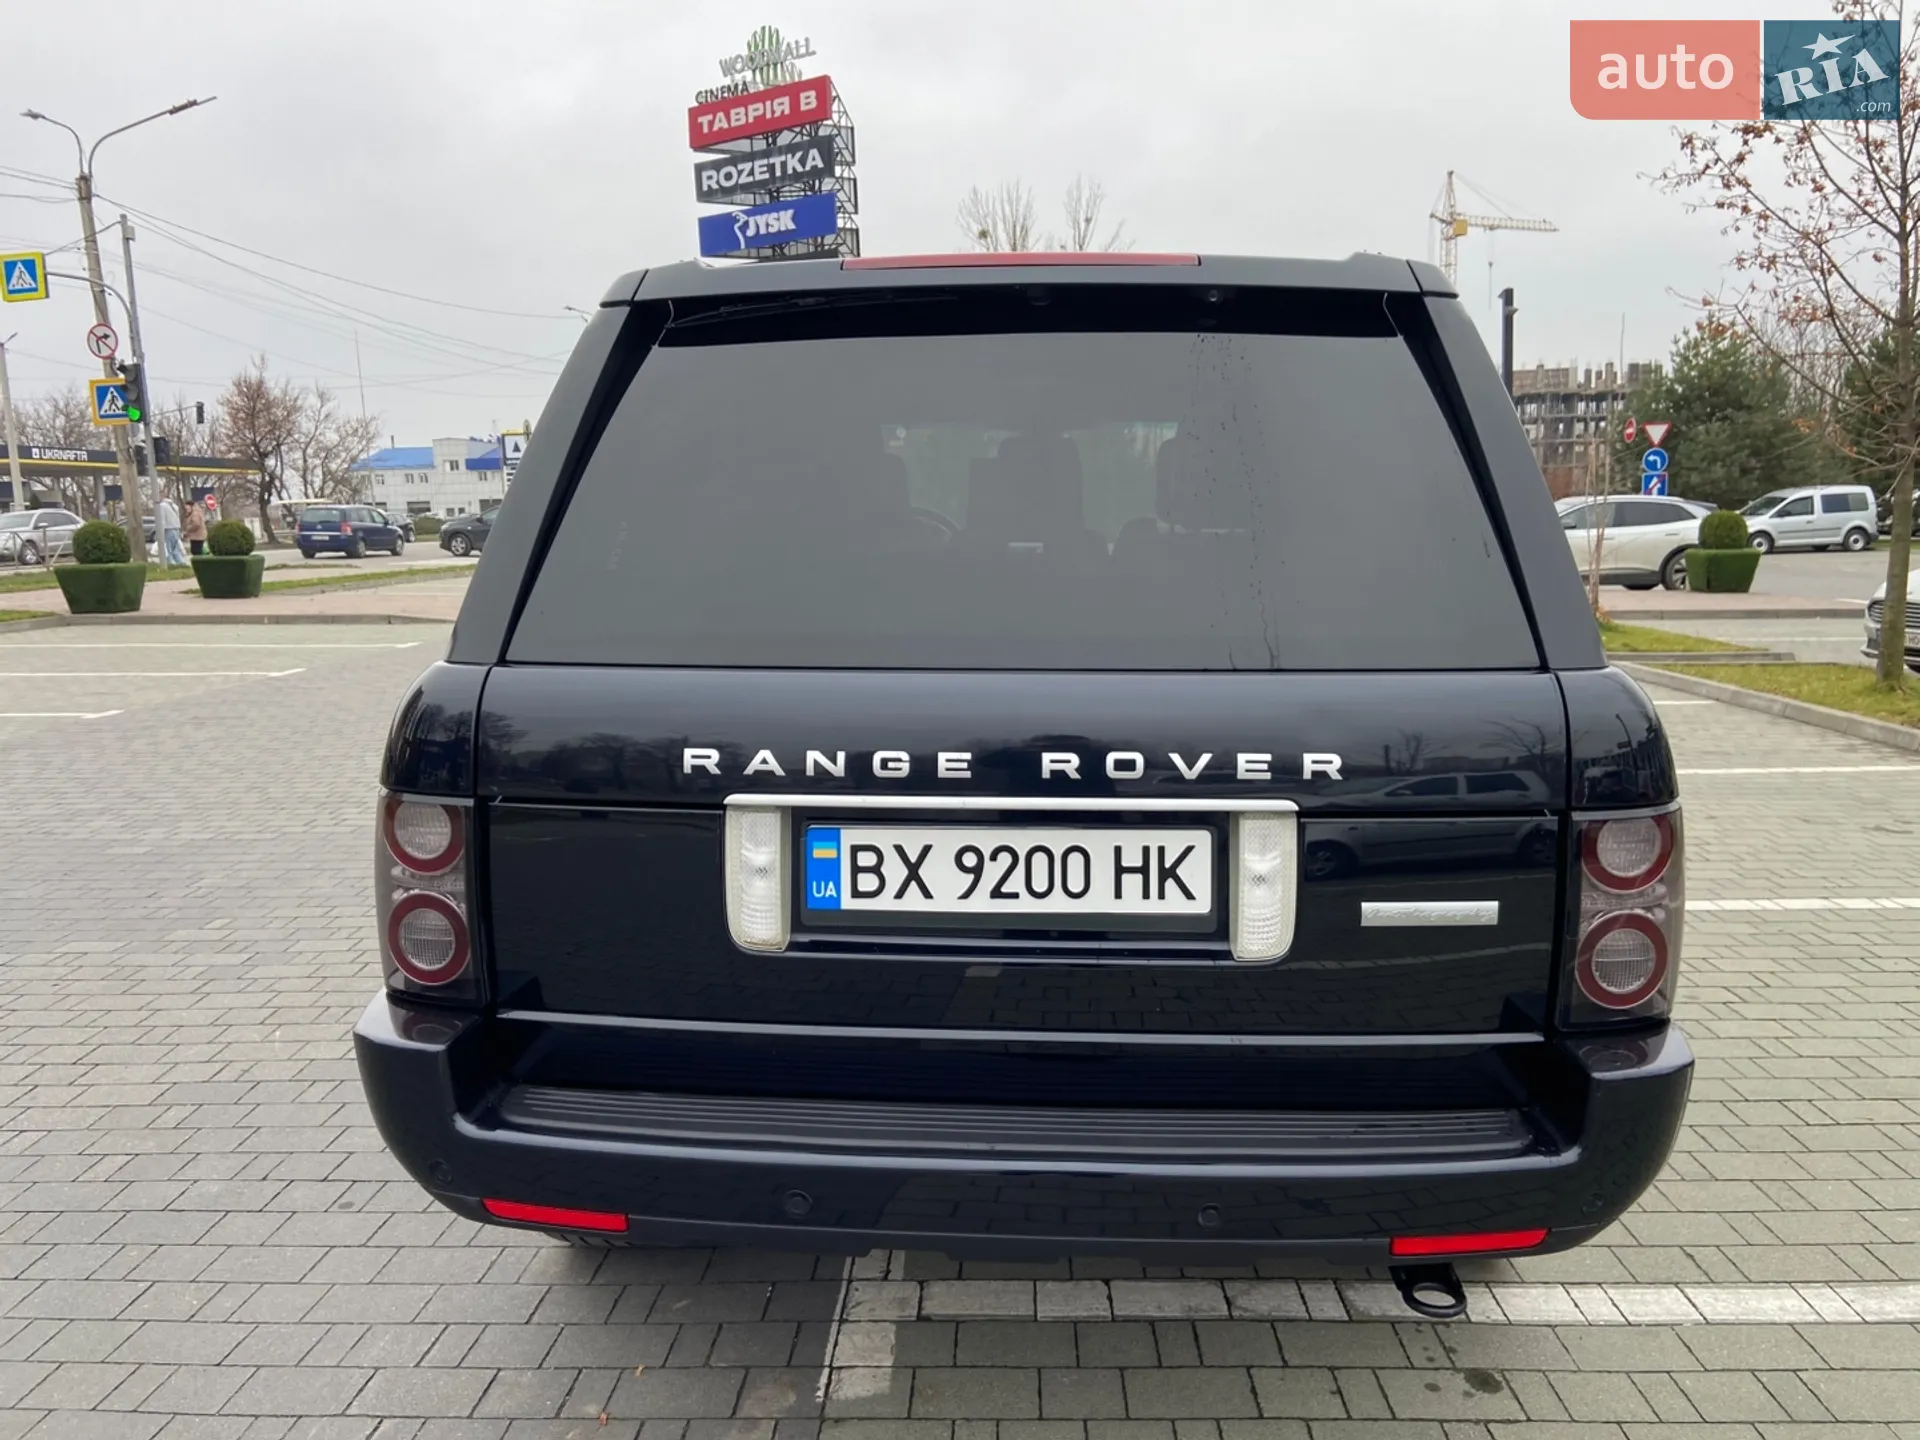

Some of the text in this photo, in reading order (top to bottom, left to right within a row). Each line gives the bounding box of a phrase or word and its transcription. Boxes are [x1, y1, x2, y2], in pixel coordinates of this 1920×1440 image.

[695, 80, 750, 105] CINEMA
[697, 95, 790, 134] ТАВРІЯ
[701, 148, 825, 192] ROZETKA
[745, 209, 797, 237] JYSK
[682, 747, 1343, 781] RANGE ROVER
[849, 843, 1197, 901] BX 9200 HK
[811, 881, 837, 899] UA
